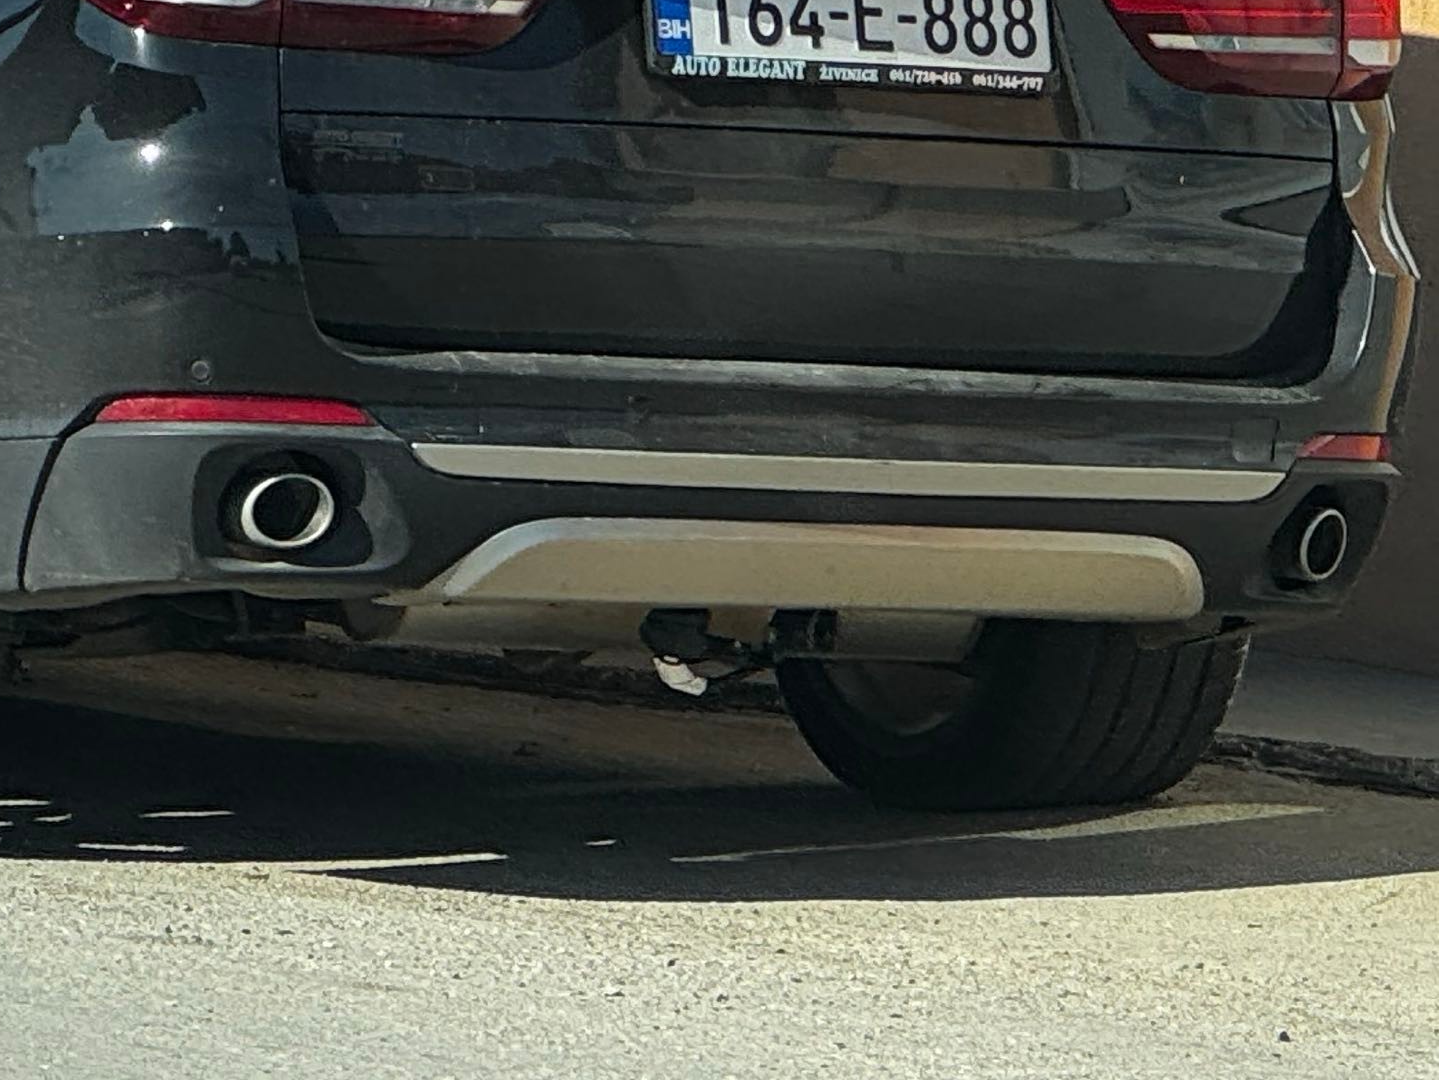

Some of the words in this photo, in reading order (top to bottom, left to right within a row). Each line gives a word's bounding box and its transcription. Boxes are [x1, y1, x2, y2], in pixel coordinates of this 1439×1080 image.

[658, 18, 691, 40] BIH
[671, 54, 721, 77] AUTO
[726, 57, 806, 80] ELEGANT
